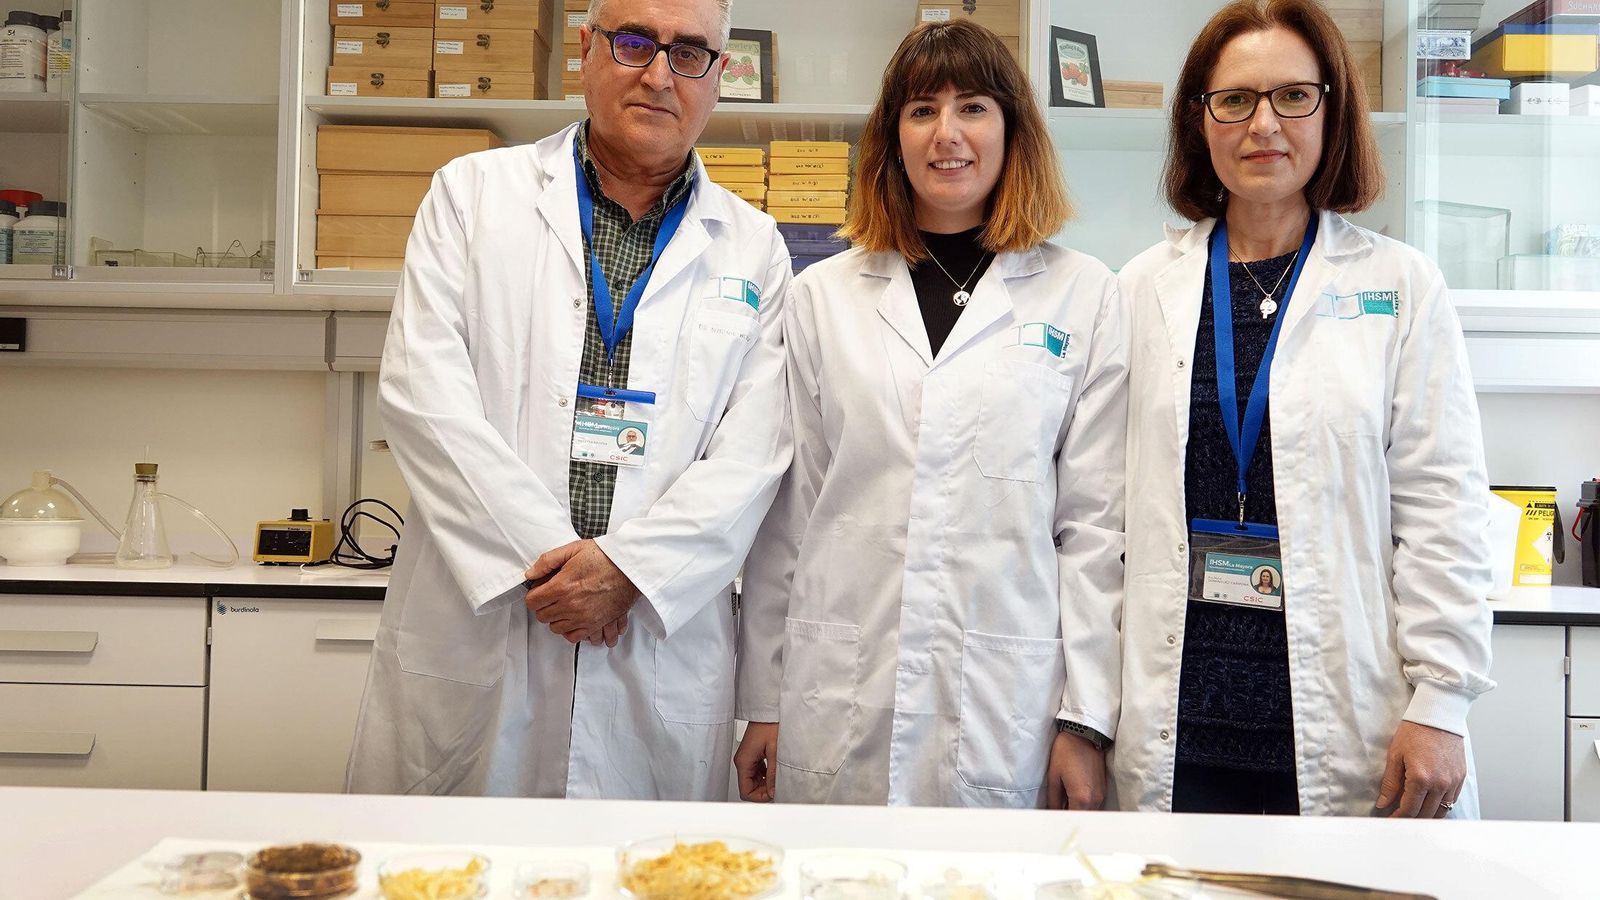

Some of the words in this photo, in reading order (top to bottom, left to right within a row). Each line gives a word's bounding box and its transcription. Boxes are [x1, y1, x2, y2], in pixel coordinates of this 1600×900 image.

[1364, 292, 1392, 301] IHSM
[609, 454, 629, 462] CSIC
[1209, 559, 1229, 567] IHSM
[1243, 595, 1264, 603] CSIC
